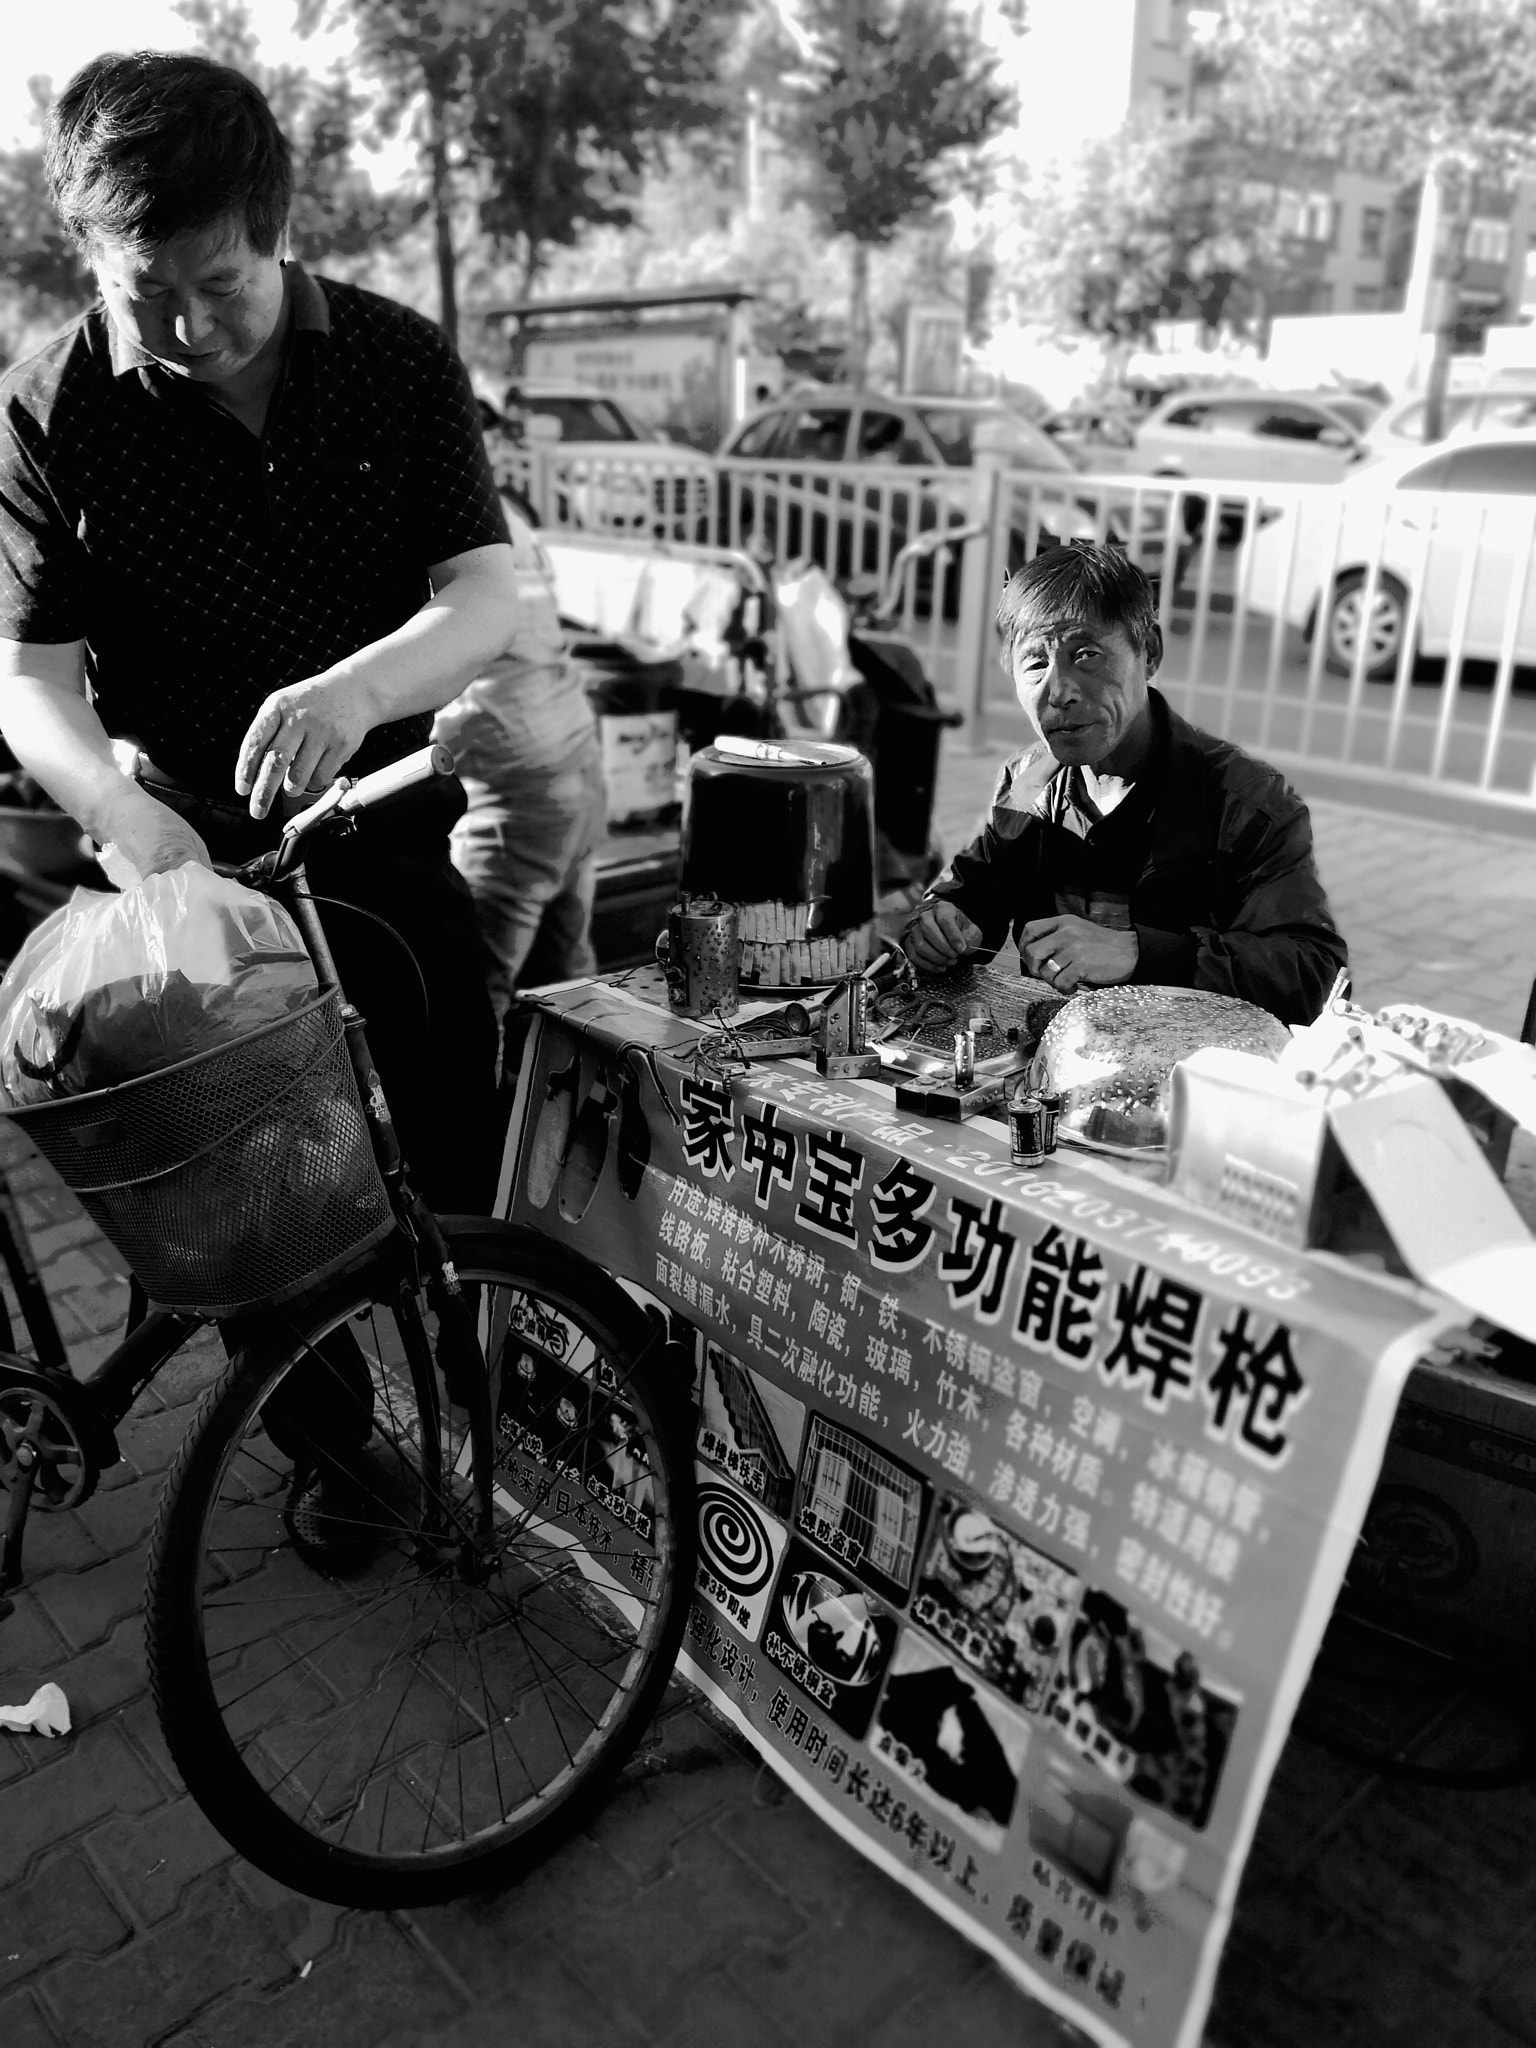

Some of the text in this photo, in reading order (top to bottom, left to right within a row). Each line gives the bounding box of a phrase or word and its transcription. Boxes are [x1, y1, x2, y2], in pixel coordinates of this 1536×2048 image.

[678, 1076, 1308, 1474] 家中宝多功能焊枪
